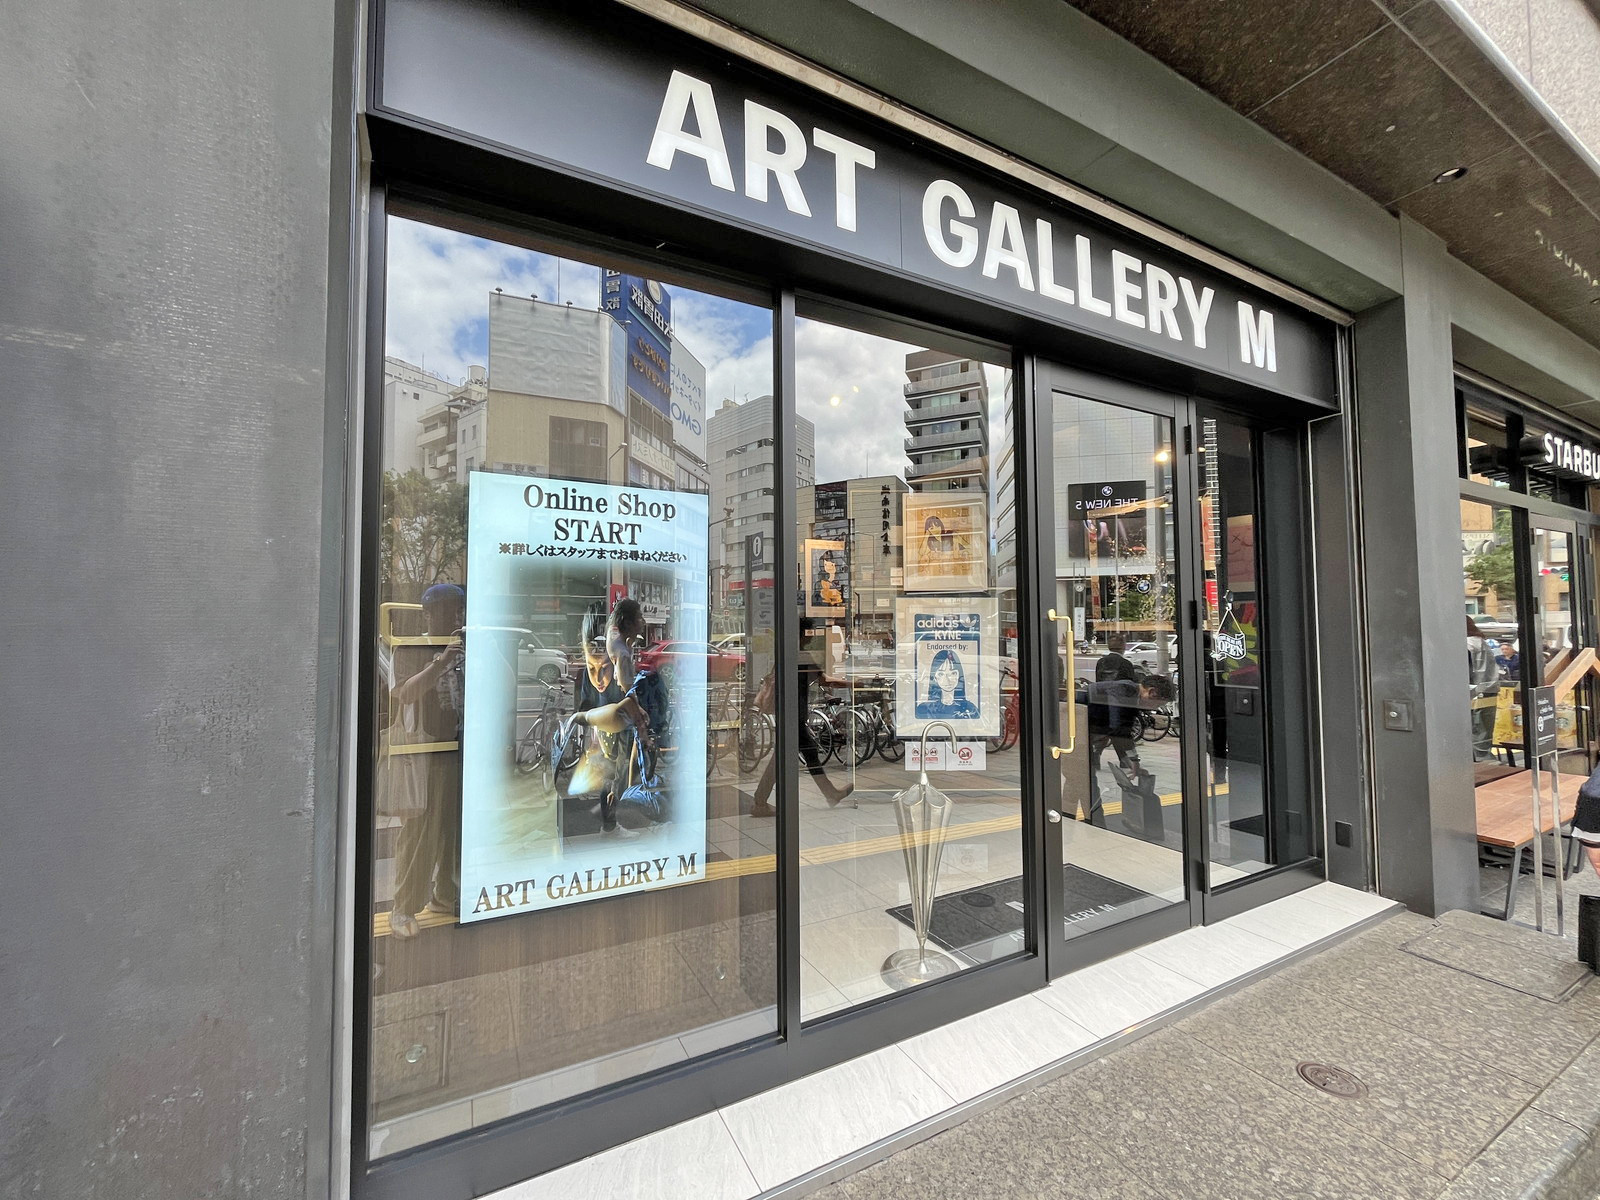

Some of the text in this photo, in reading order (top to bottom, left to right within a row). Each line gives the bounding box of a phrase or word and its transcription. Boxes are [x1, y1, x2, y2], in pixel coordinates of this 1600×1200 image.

[646, 69, 1277, 373] ART GALLERY M
[1544, 432, 1600, 480] STARBU
[523, 484, 676, 522] Online Shop
[554, 517, 642, 546] START
[917, 617, 959, 628] adidas
[958, 643, 968, 651] by:
[1218, 640, 1244, 656] OPEN
[472, 852, 698, 914] ART GALLERY M
